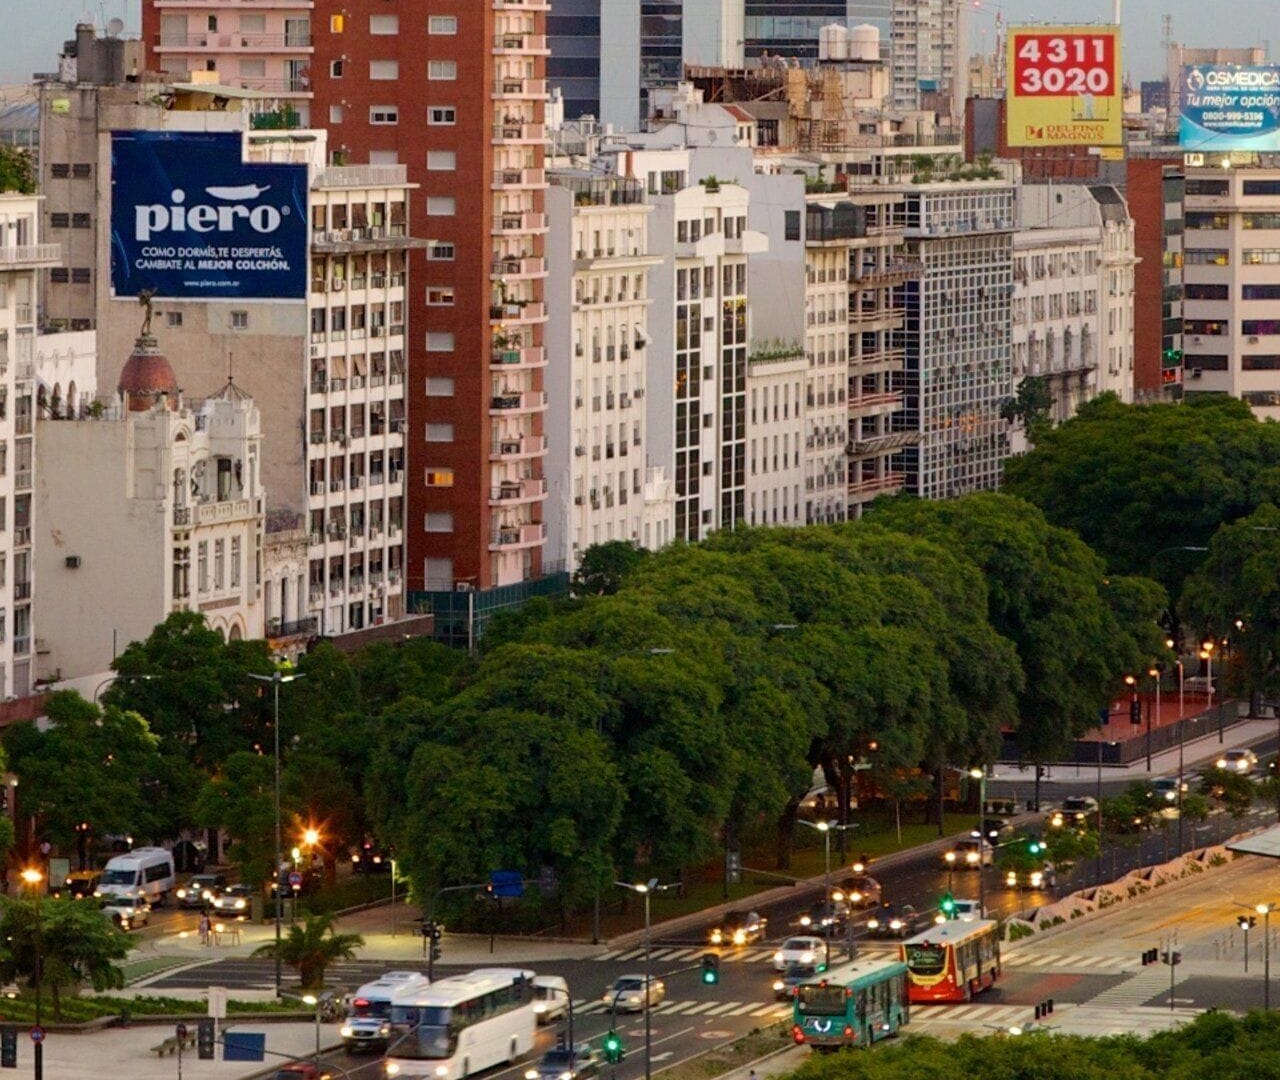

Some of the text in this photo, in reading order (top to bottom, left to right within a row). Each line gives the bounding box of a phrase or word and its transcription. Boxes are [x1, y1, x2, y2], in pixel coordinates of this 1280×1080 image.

[1018, 38, 1105, 63] 4311
[1021, 67, 1109, 92] 3020
[1206, 71, 1280, 85] OSMEDICA
[1186, 93, 1280, 108] Tu mejor opción
[1046, 125, 1104, 133] DELFINO
[1046, 132, 1104, 141] MAGNUS
[135, 188, 281, 241] piero
[142, 247, 176, 258] COMO
[135, 259, 182, 270] CAMBIATE
[184, 260, 196, 269] AL
[198, 260, 233, 270] MEJOR
